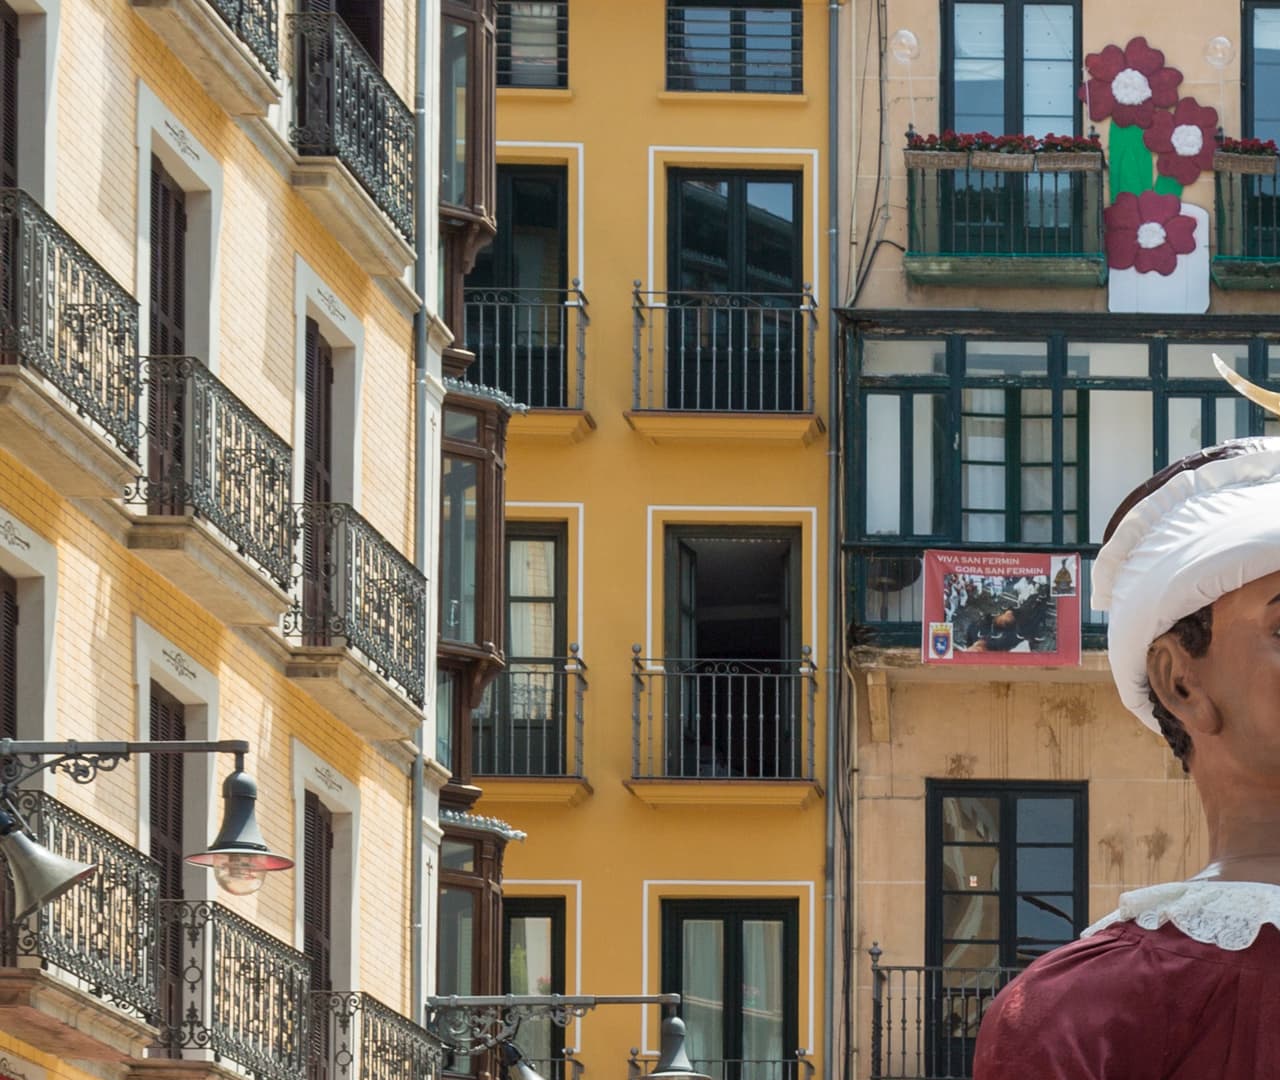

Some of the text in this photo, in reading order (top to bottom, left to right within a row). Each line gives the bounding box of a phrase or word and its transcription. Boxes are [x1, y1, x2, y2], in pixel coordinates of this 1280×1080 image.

[937, 555, 1020, 565] VIVA SAN FERMIN
[955, 566, 1044, 575] GORA SAN FERMIN
